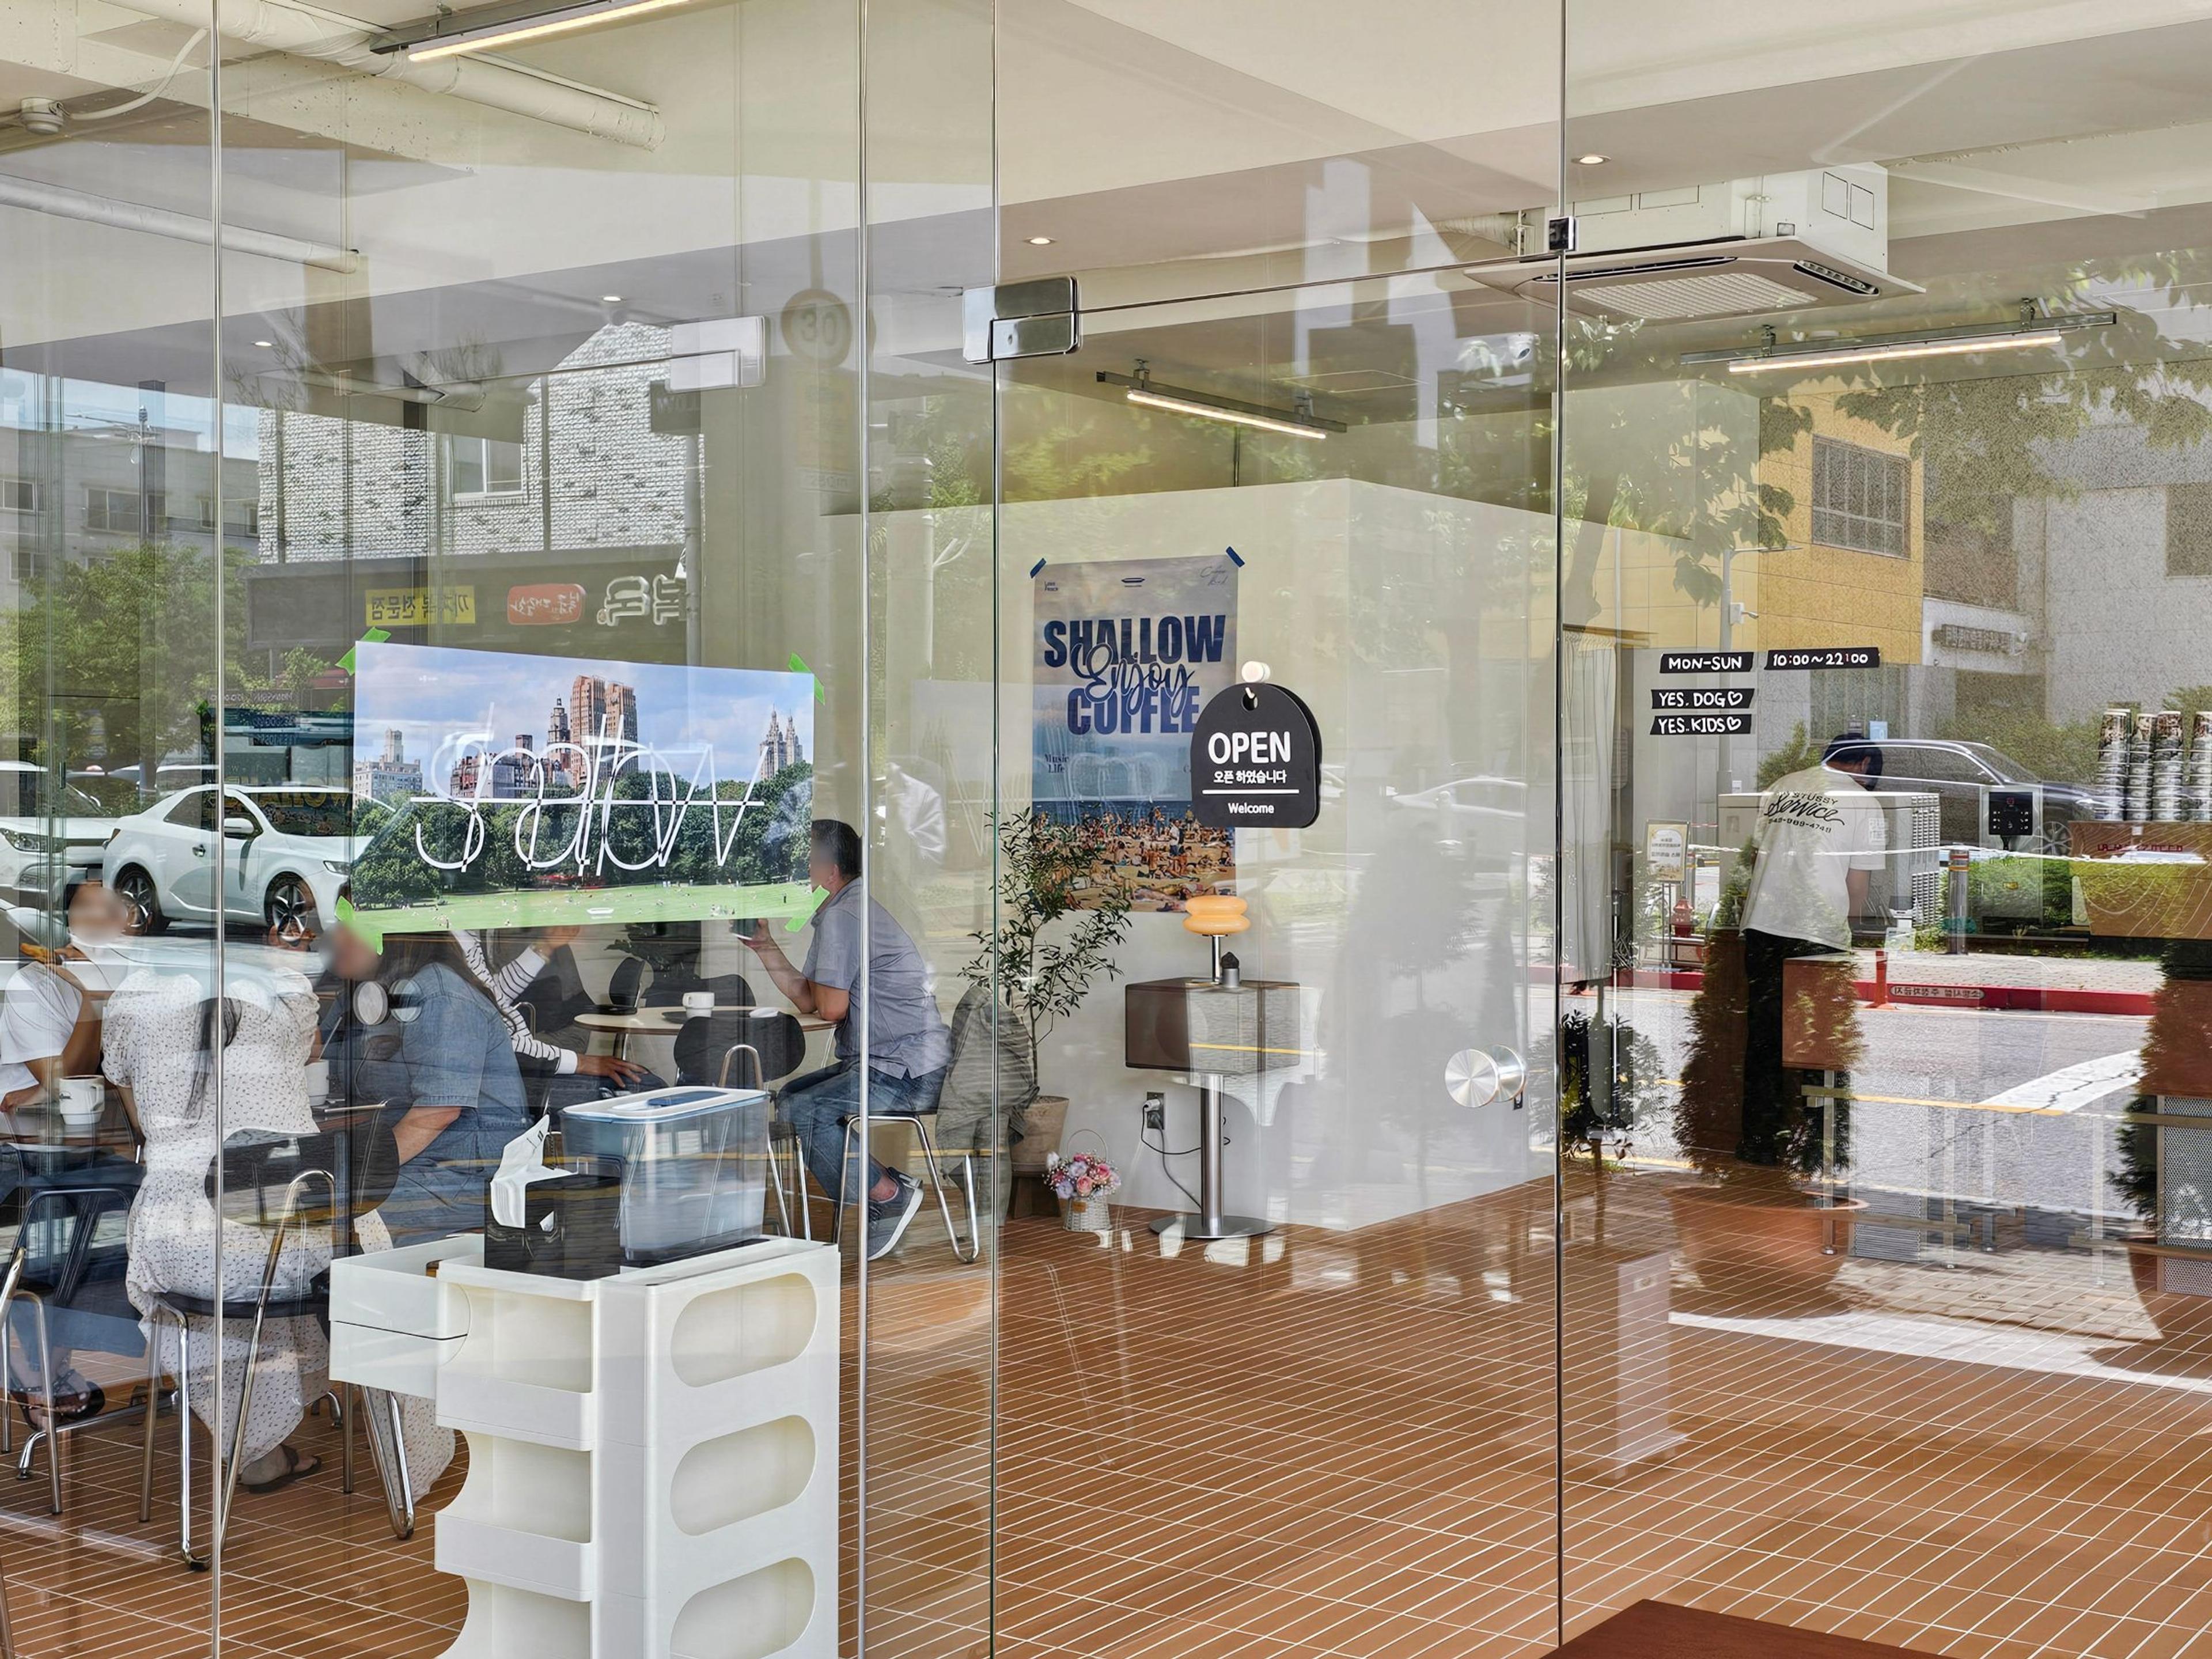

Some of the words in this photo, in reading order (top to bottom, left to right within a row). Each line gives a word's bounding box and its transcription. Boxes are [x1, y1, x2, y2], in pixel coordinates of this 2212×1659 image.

[801, 306, 838, 345] 30
[1044, 615, 1226, 668] SHALLOW
[1669, 656, 1742, 672] MON-SUN
[1070, 642, 1195, 718] Enjoy
[1693, 692, 1725, 707] DOG
[1691, 717, 1725, 733] KIDS
[1208, 732, 1291, 764] OPEN
[1045, 753, 1069, 763] Music
[1048, 763, 1065, 774] Life
[1214, 770, 1234, 784] 오픈
[1236, 770, 1287, 784] 하였습니다
[1228, 802, 1275, 814] Welcome
[1764, 793, 1845, 825] Service
